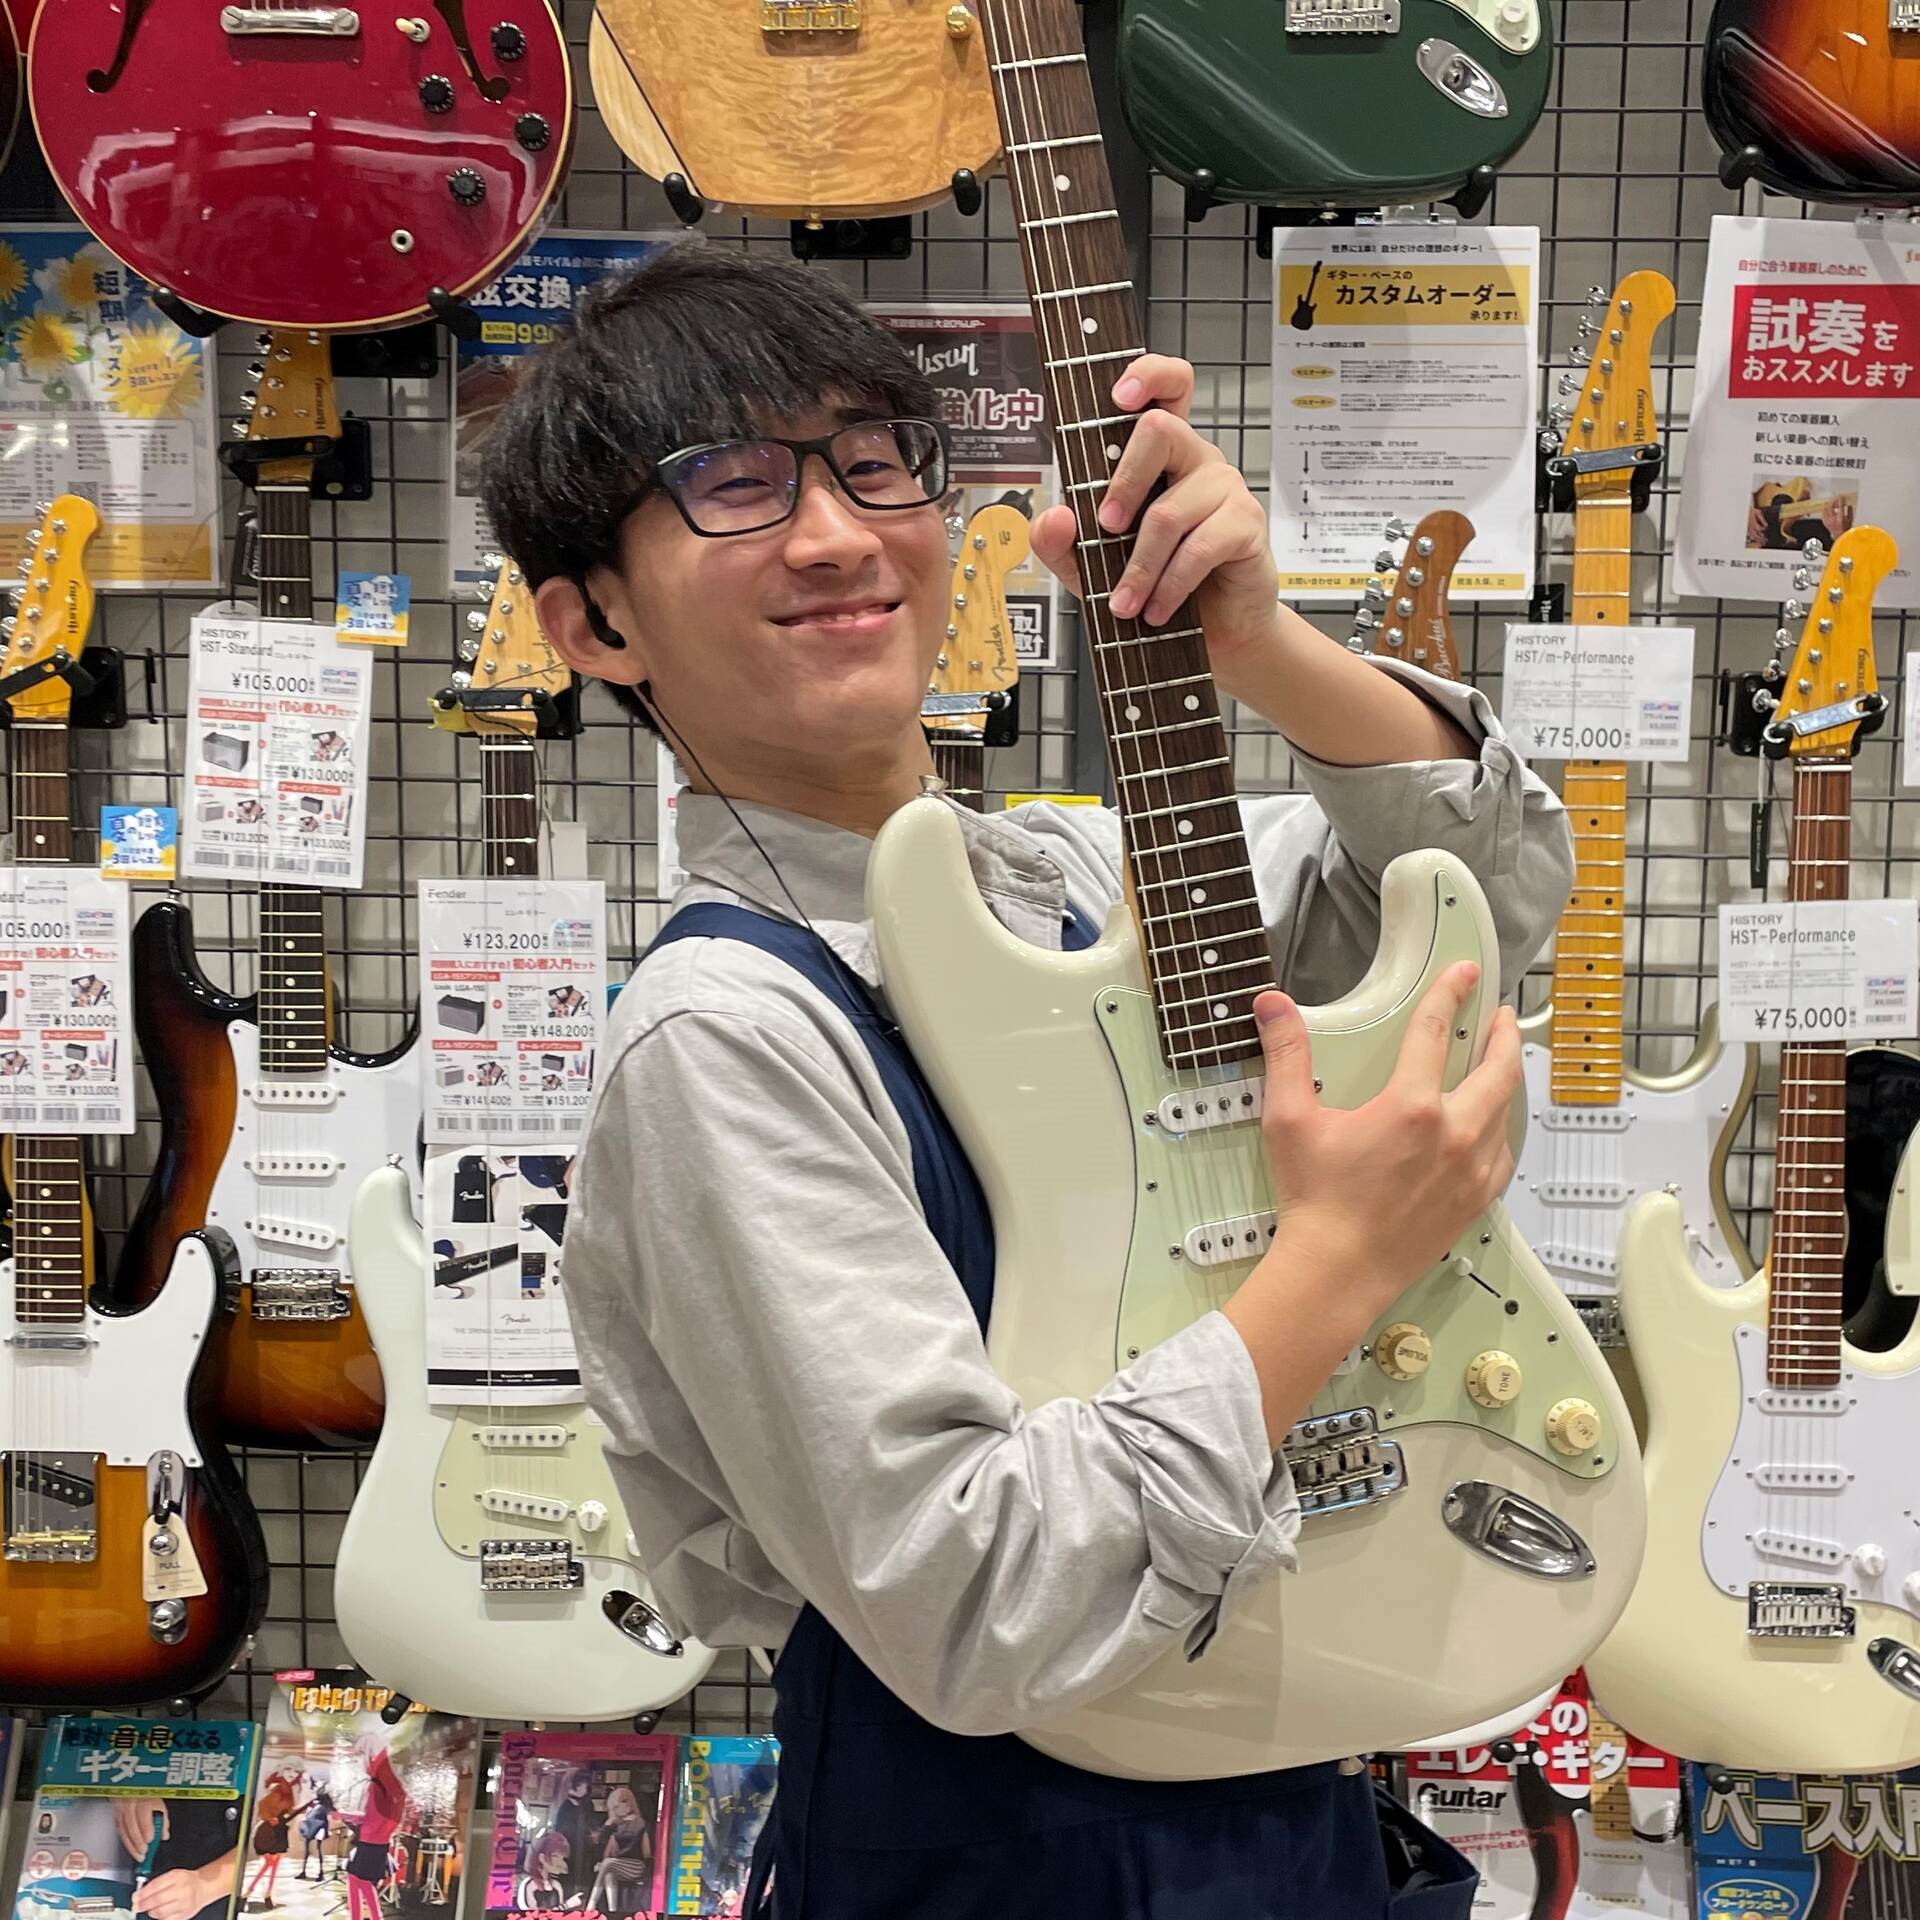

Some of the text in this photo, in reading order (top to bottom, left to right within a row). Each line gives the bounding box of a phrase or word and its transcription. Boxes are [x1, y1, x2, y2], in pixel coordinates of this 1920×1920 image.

[1327, 269, 1413, 281] ギター・ベースの
[1738, 260, 1867, 276] 自分に合う楽器探しのために
[1336, 283, 1516, 306] カスタムオーダー
[1470, 310, 1518, 321] 承ります!
[1747, 297, 1899, 357] 試奏を
[1742, 355, 1914, 388] おススメします
[1758, 411, 1840, 426] 初めての楽器購入
[1755, 432, 1869, 449] 新しい楽器への買い替え
[1753, 453, 1867, 470] 気になる楽器の比較検討
[201, 629, 249, 640] HISTORY
[1516, 635, 1567, 646] HISTORY
[984, 623, 1014, 683] Fender
[1515, 650, 1635, 665] HST/m-Performance
[1534, 727, 1623, 749] ¥75,000
[428, 888, 466, 899] Fender
[1730, 915, 1784, 926] HISTORY
[463, 932, 541, 950] ¥123,200
[1730, 928, 1856, 945] HST-Performance
[1755, 1006, 1847, 1030] ¥75,000
[530, 1024, 589, 1038] ¥148,200
[1498, 1371, 1512, 1393] TONE
[80, 1749, 236, 1786] ギター調整
[1417, 1783, 1507, 1809] Guitar
